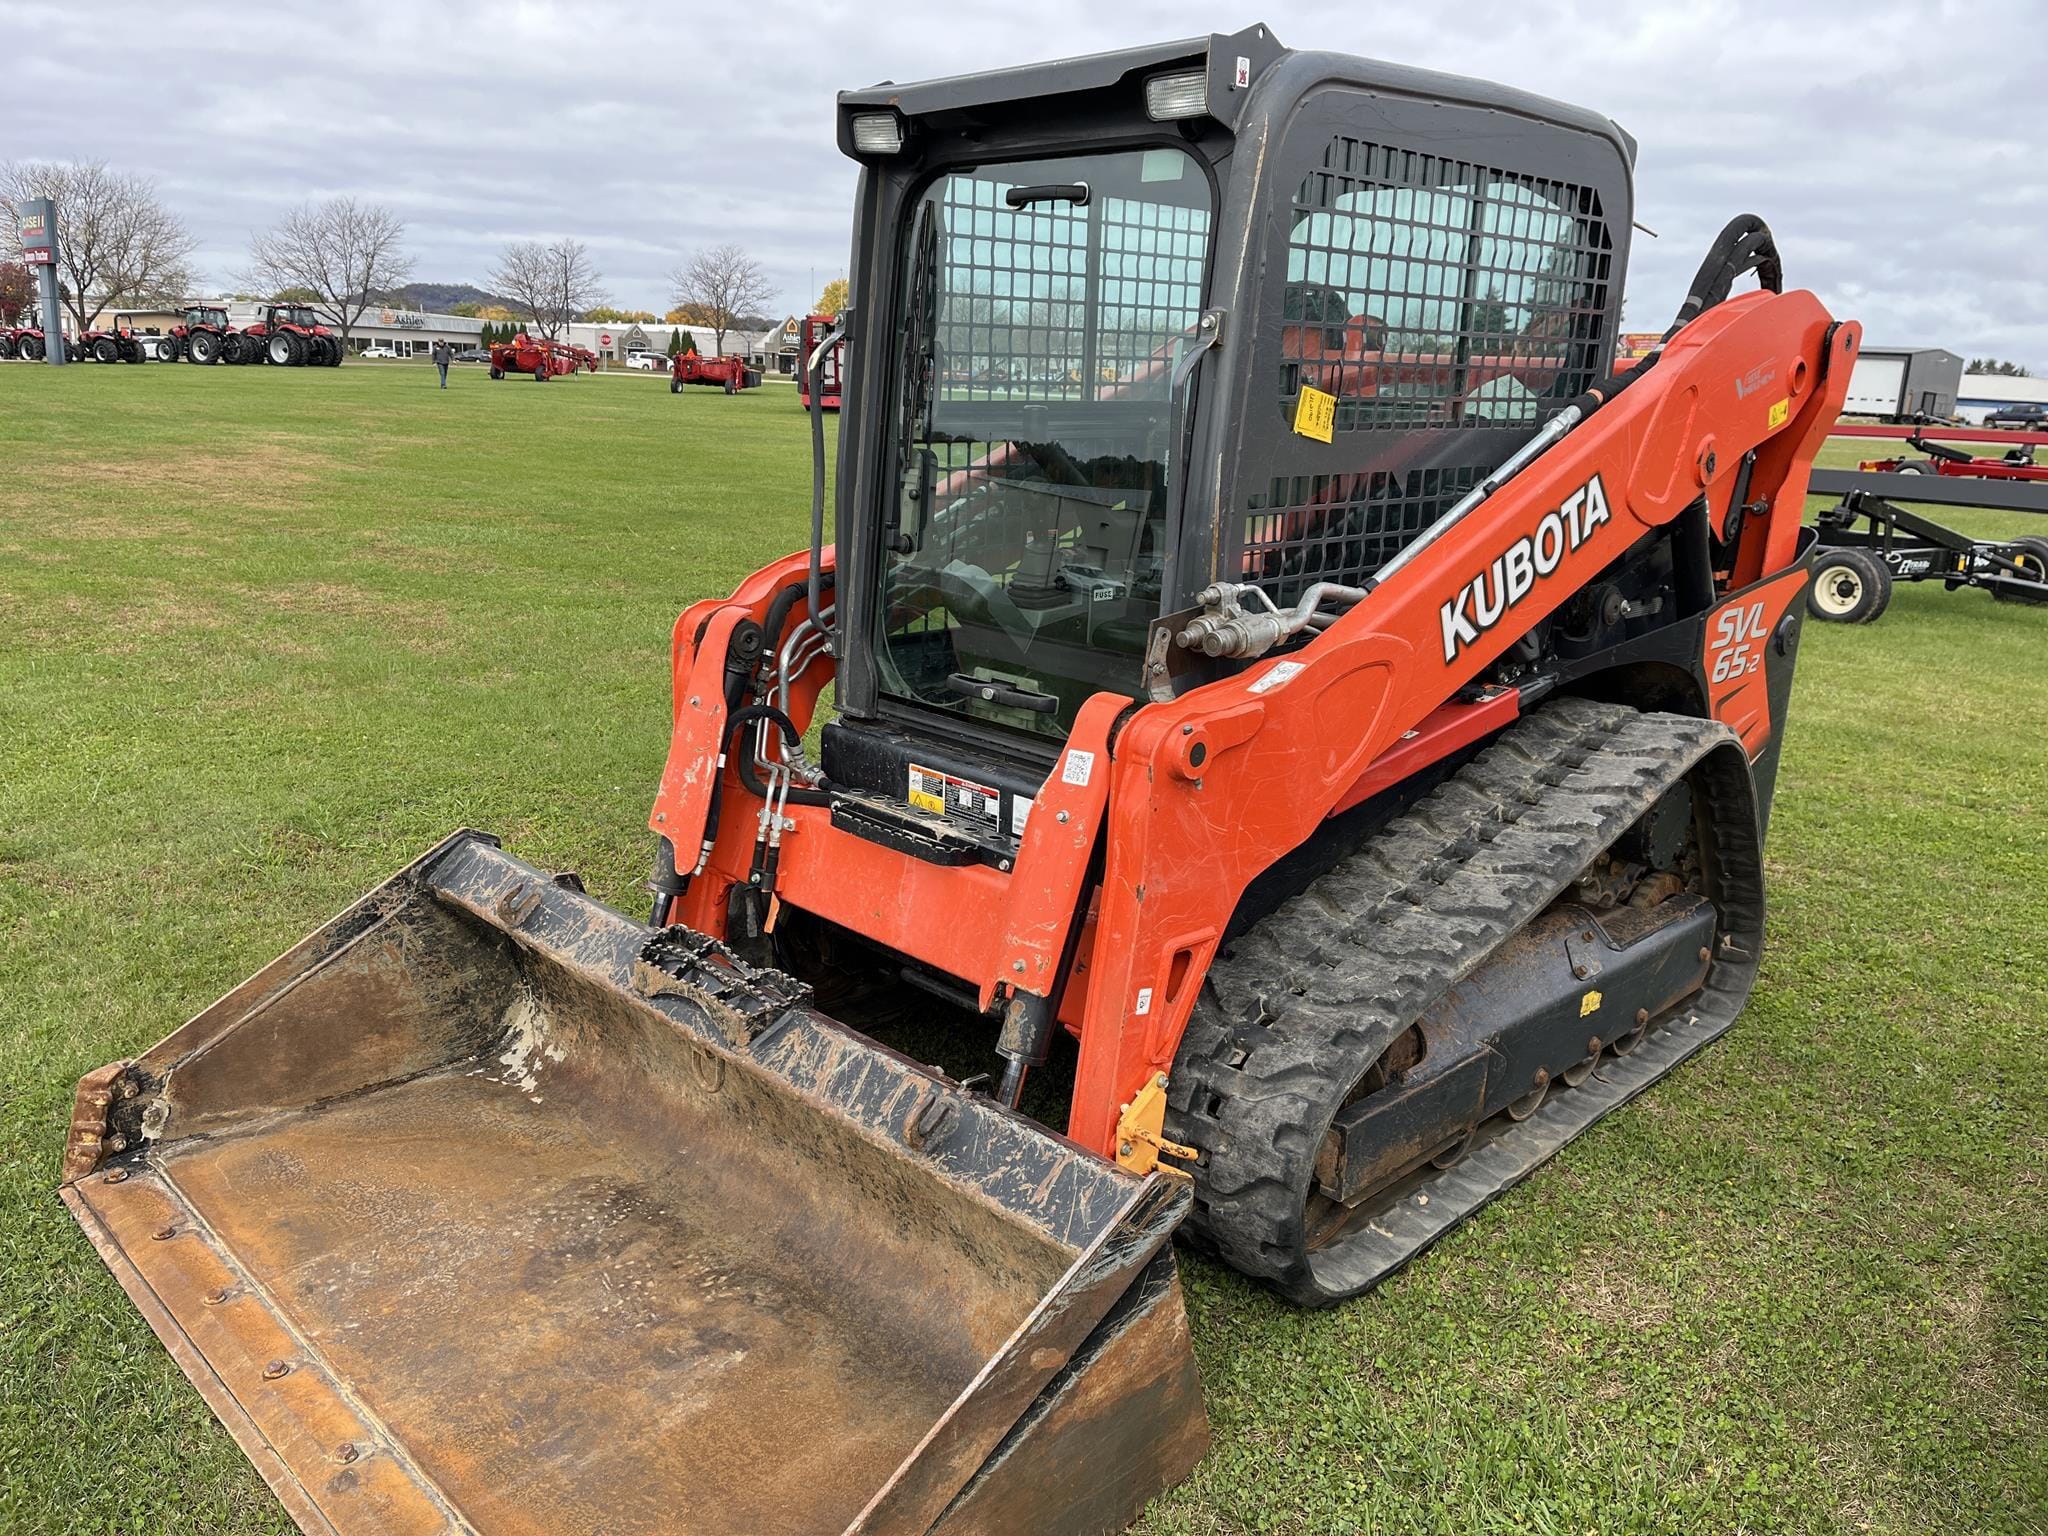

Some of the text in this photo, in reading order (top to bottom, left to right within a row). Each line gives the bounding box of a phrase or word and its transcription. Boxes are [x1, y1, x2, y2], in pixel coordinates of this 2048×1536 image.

[395, 314, 424, 326] Ashley
[1440, 474, 1610, 663] KUBOTA
[1095, 590, 1112, 599] FUSE
[1710, 602, 1768, 649] SVL
[1711, 644, 1760, 684] 65-2
